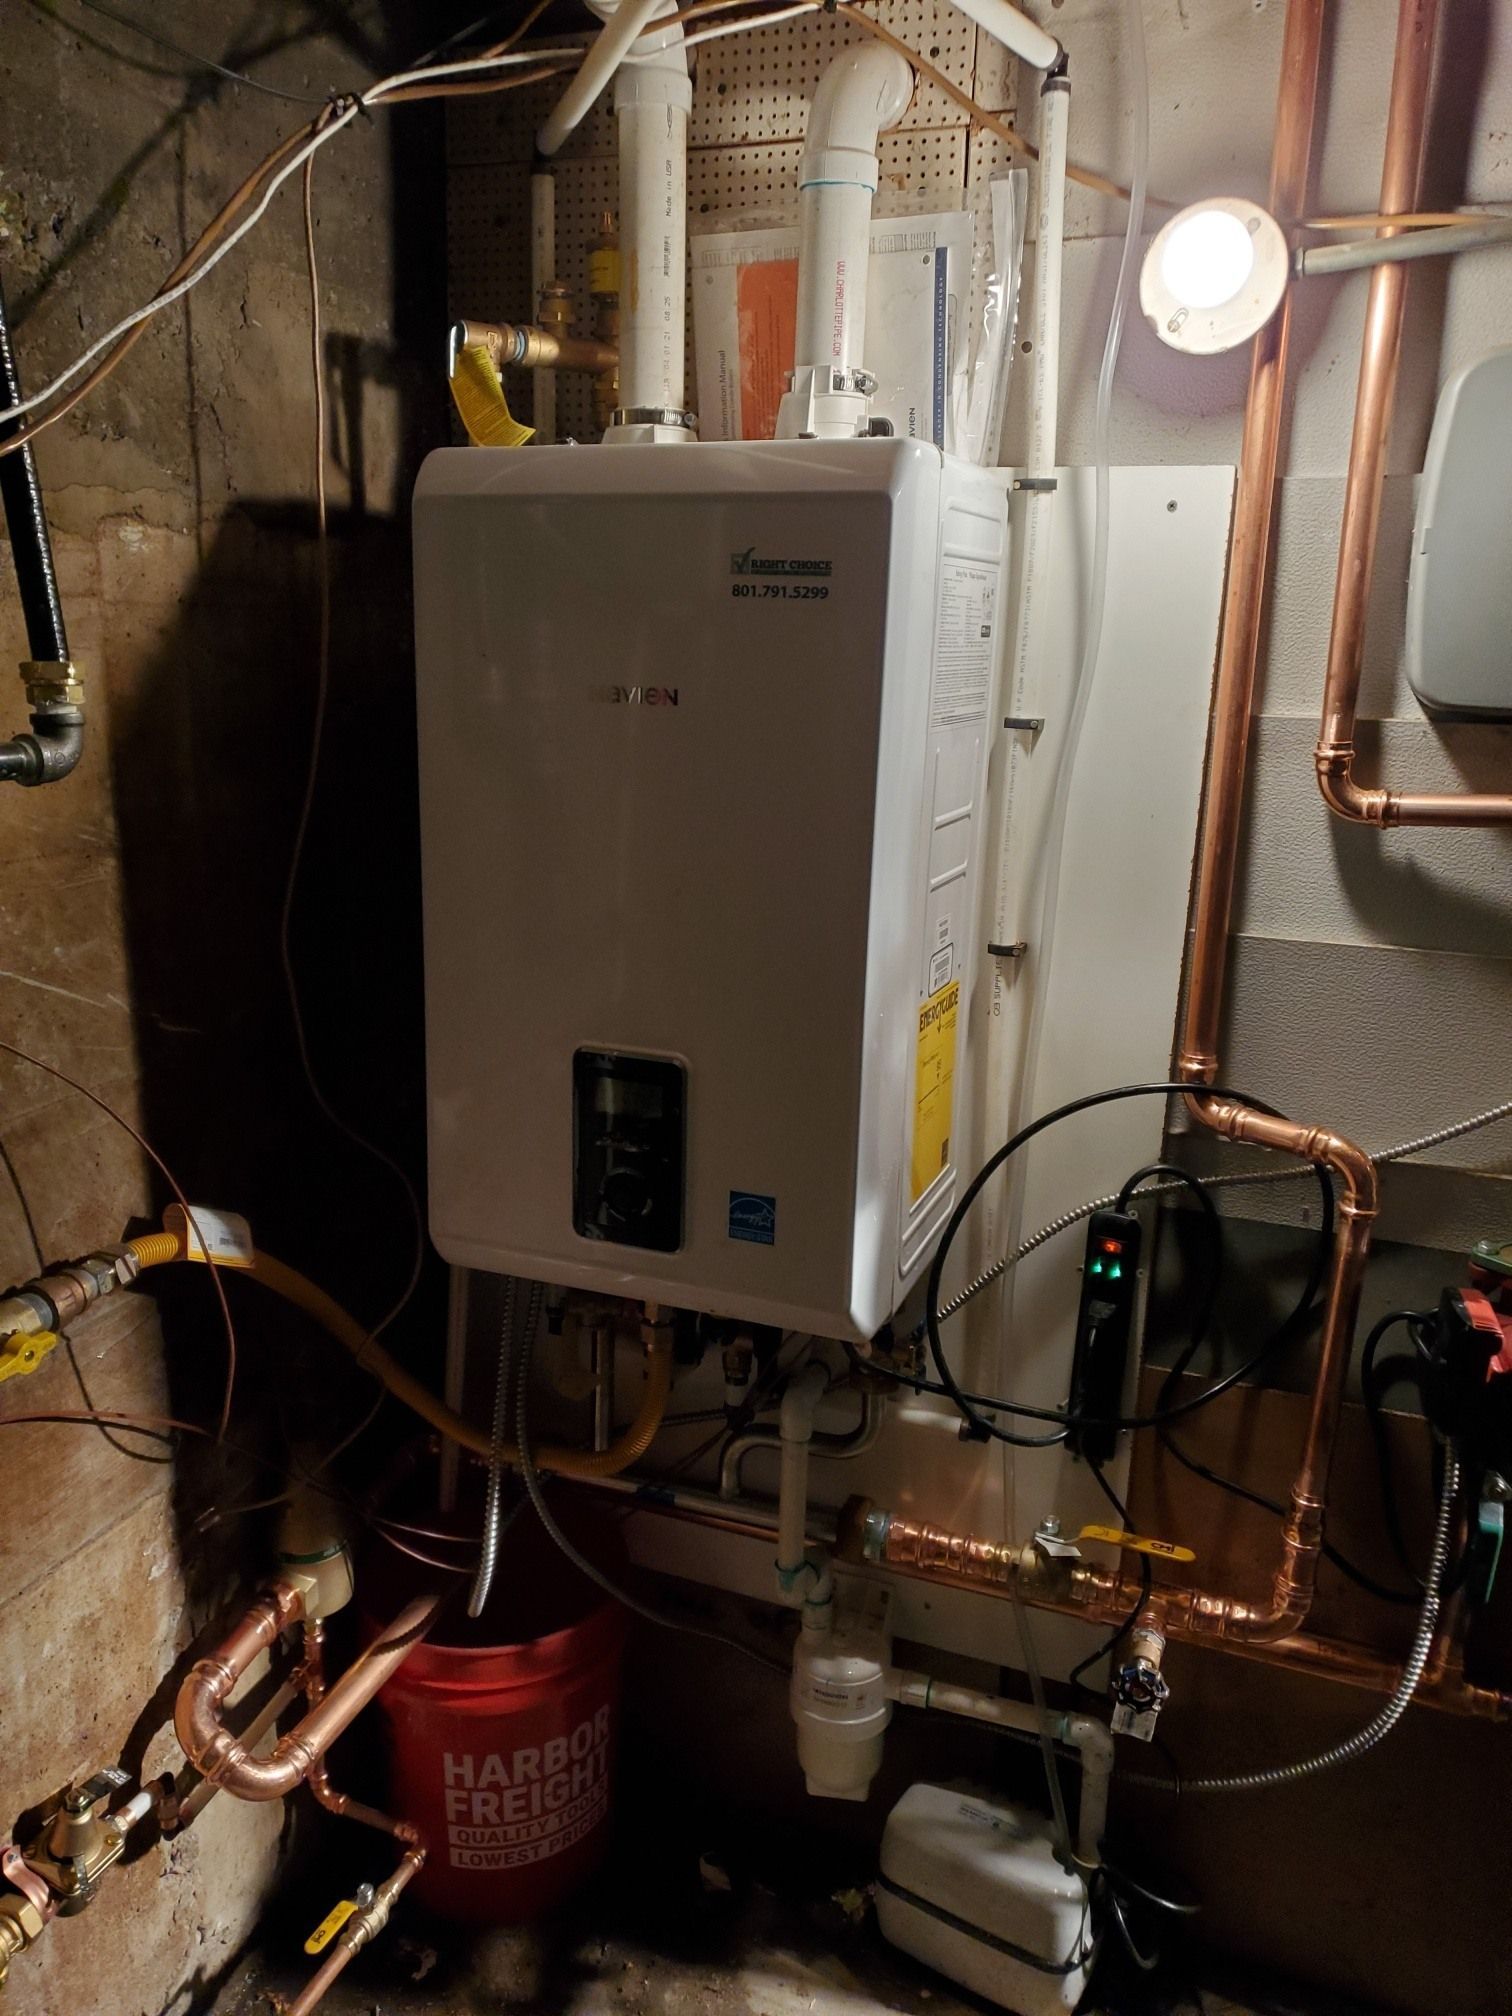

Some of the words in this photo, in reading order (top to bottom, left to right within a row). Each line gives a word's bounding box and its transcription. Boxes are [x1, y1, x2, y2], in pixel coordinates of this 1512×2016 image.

[664, 159, 672, 176] USA
[664, 196, 672, 217] Made
[832, 260, 846, 356] WWW.CHARLOTTEPIPE.COM
[717, 350, 727, 383] Manual
[719, 385, 729, 436] Information
[751, 559, 787, 569] RIGHT
[789, 560, 833, 570] CHOICE
[731, 584, 829, 599] 801.791.5299
[993, 957, 1003, 999] SUPPLIE
[443, 1703, 610, 1789] HARBOR
[445, 1741, 607, 1825] FREIGHT
[456, 1818, 548, 1844] QUALITY
[555, 1779, 605, 1825] TOOLS
[457, 1844, 543, 1867] LOWEST
